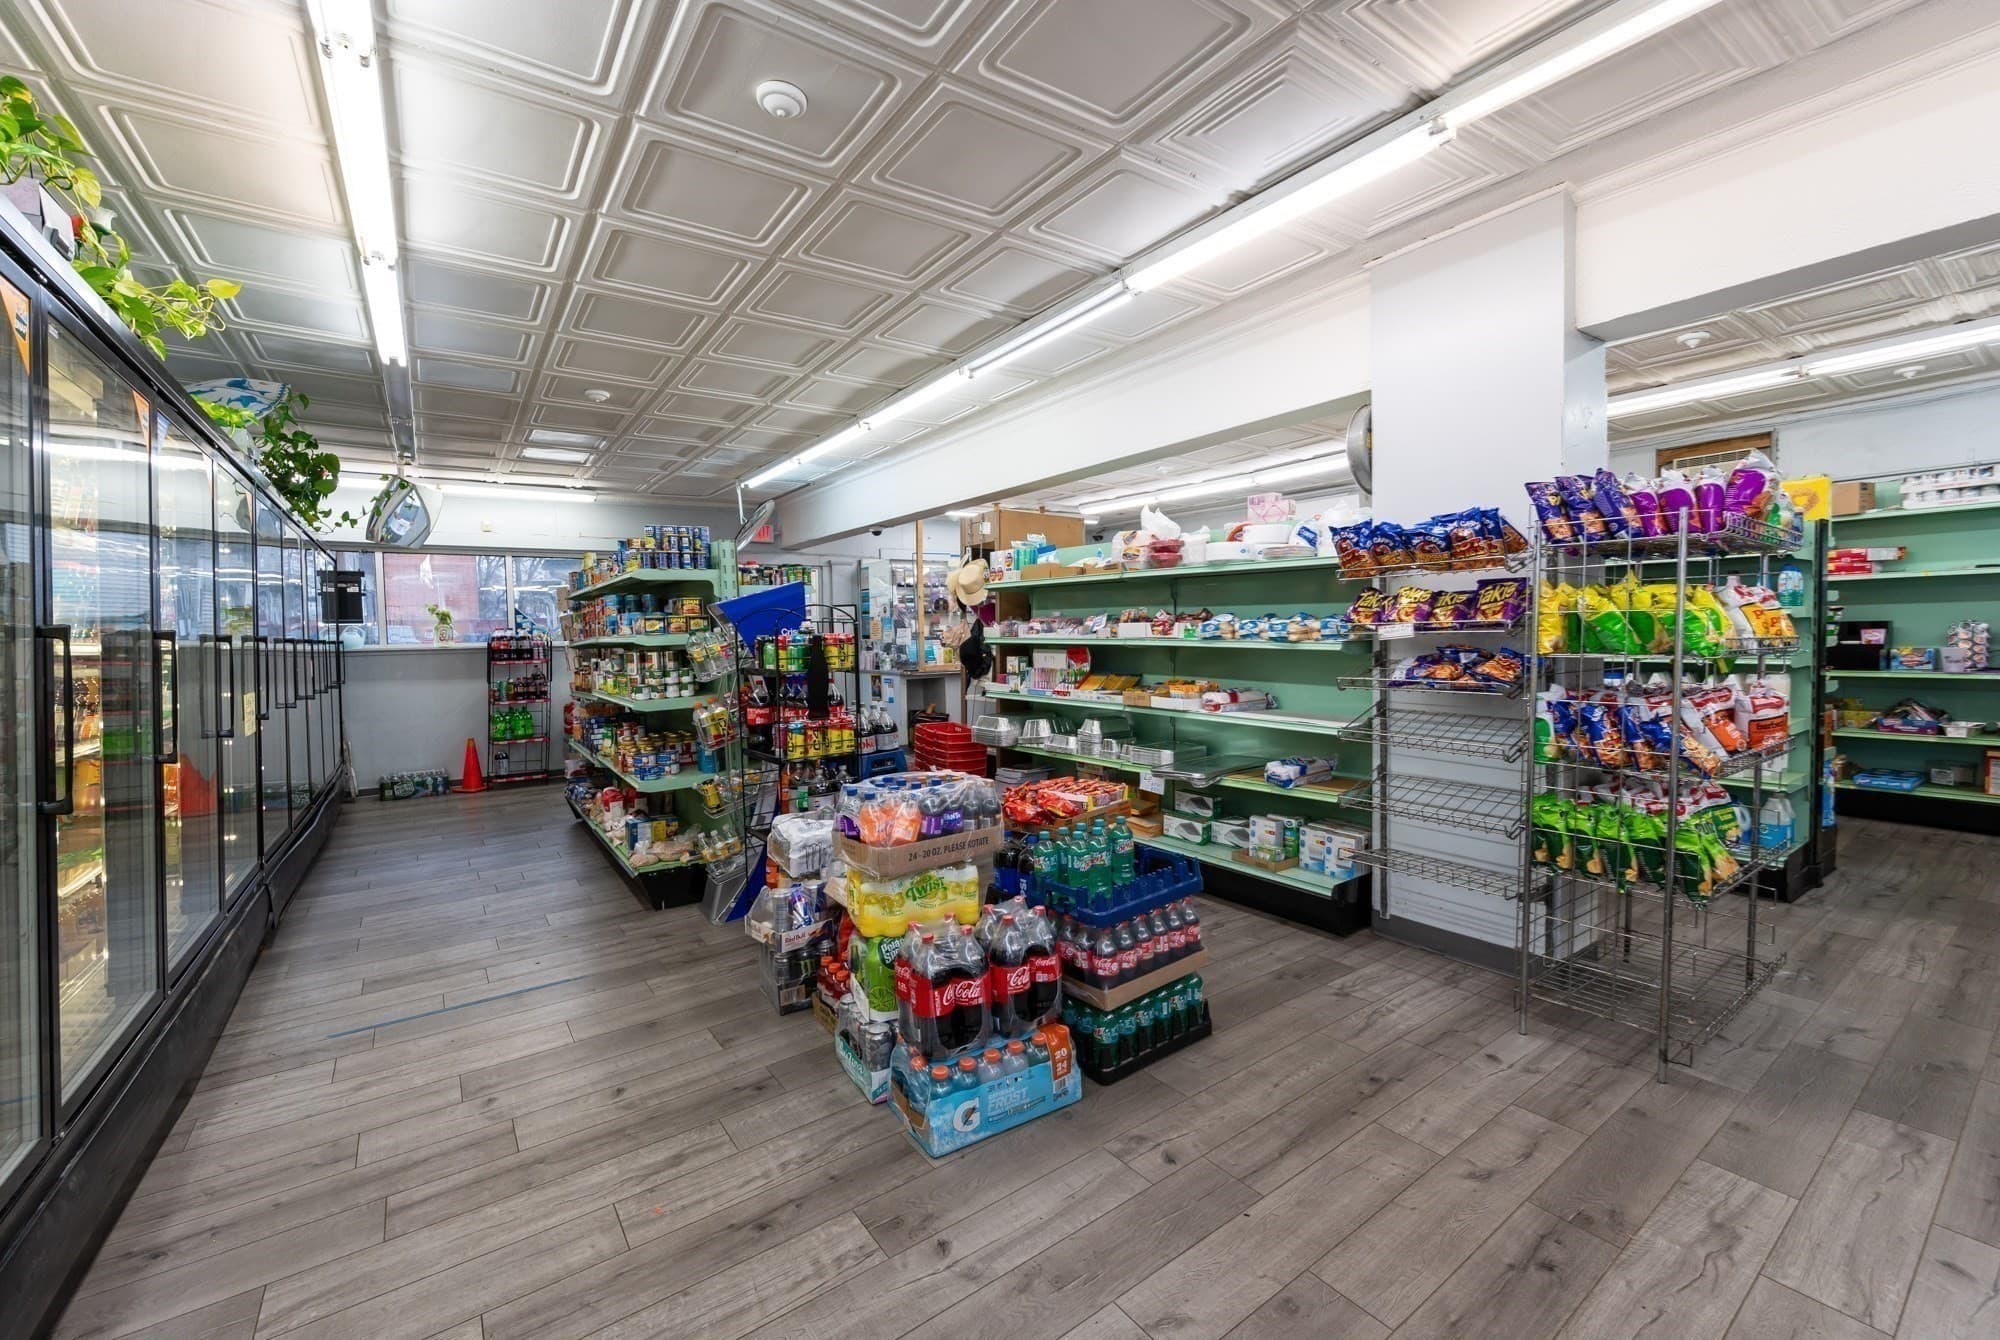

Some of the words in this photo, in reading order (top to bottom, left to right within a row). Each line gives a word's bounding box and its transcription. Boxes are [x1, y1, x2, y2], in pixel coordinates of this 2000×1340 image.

[1478, 582, 1518, 608] Takis
[908, 852, 917, 861] 24
[922, 850, 930, 860] 20
[944, 842, 966, 854] PLEASE
[968, 836, 990, 848] ROTATE
[1054, 1048, 1068, 1060] 20
